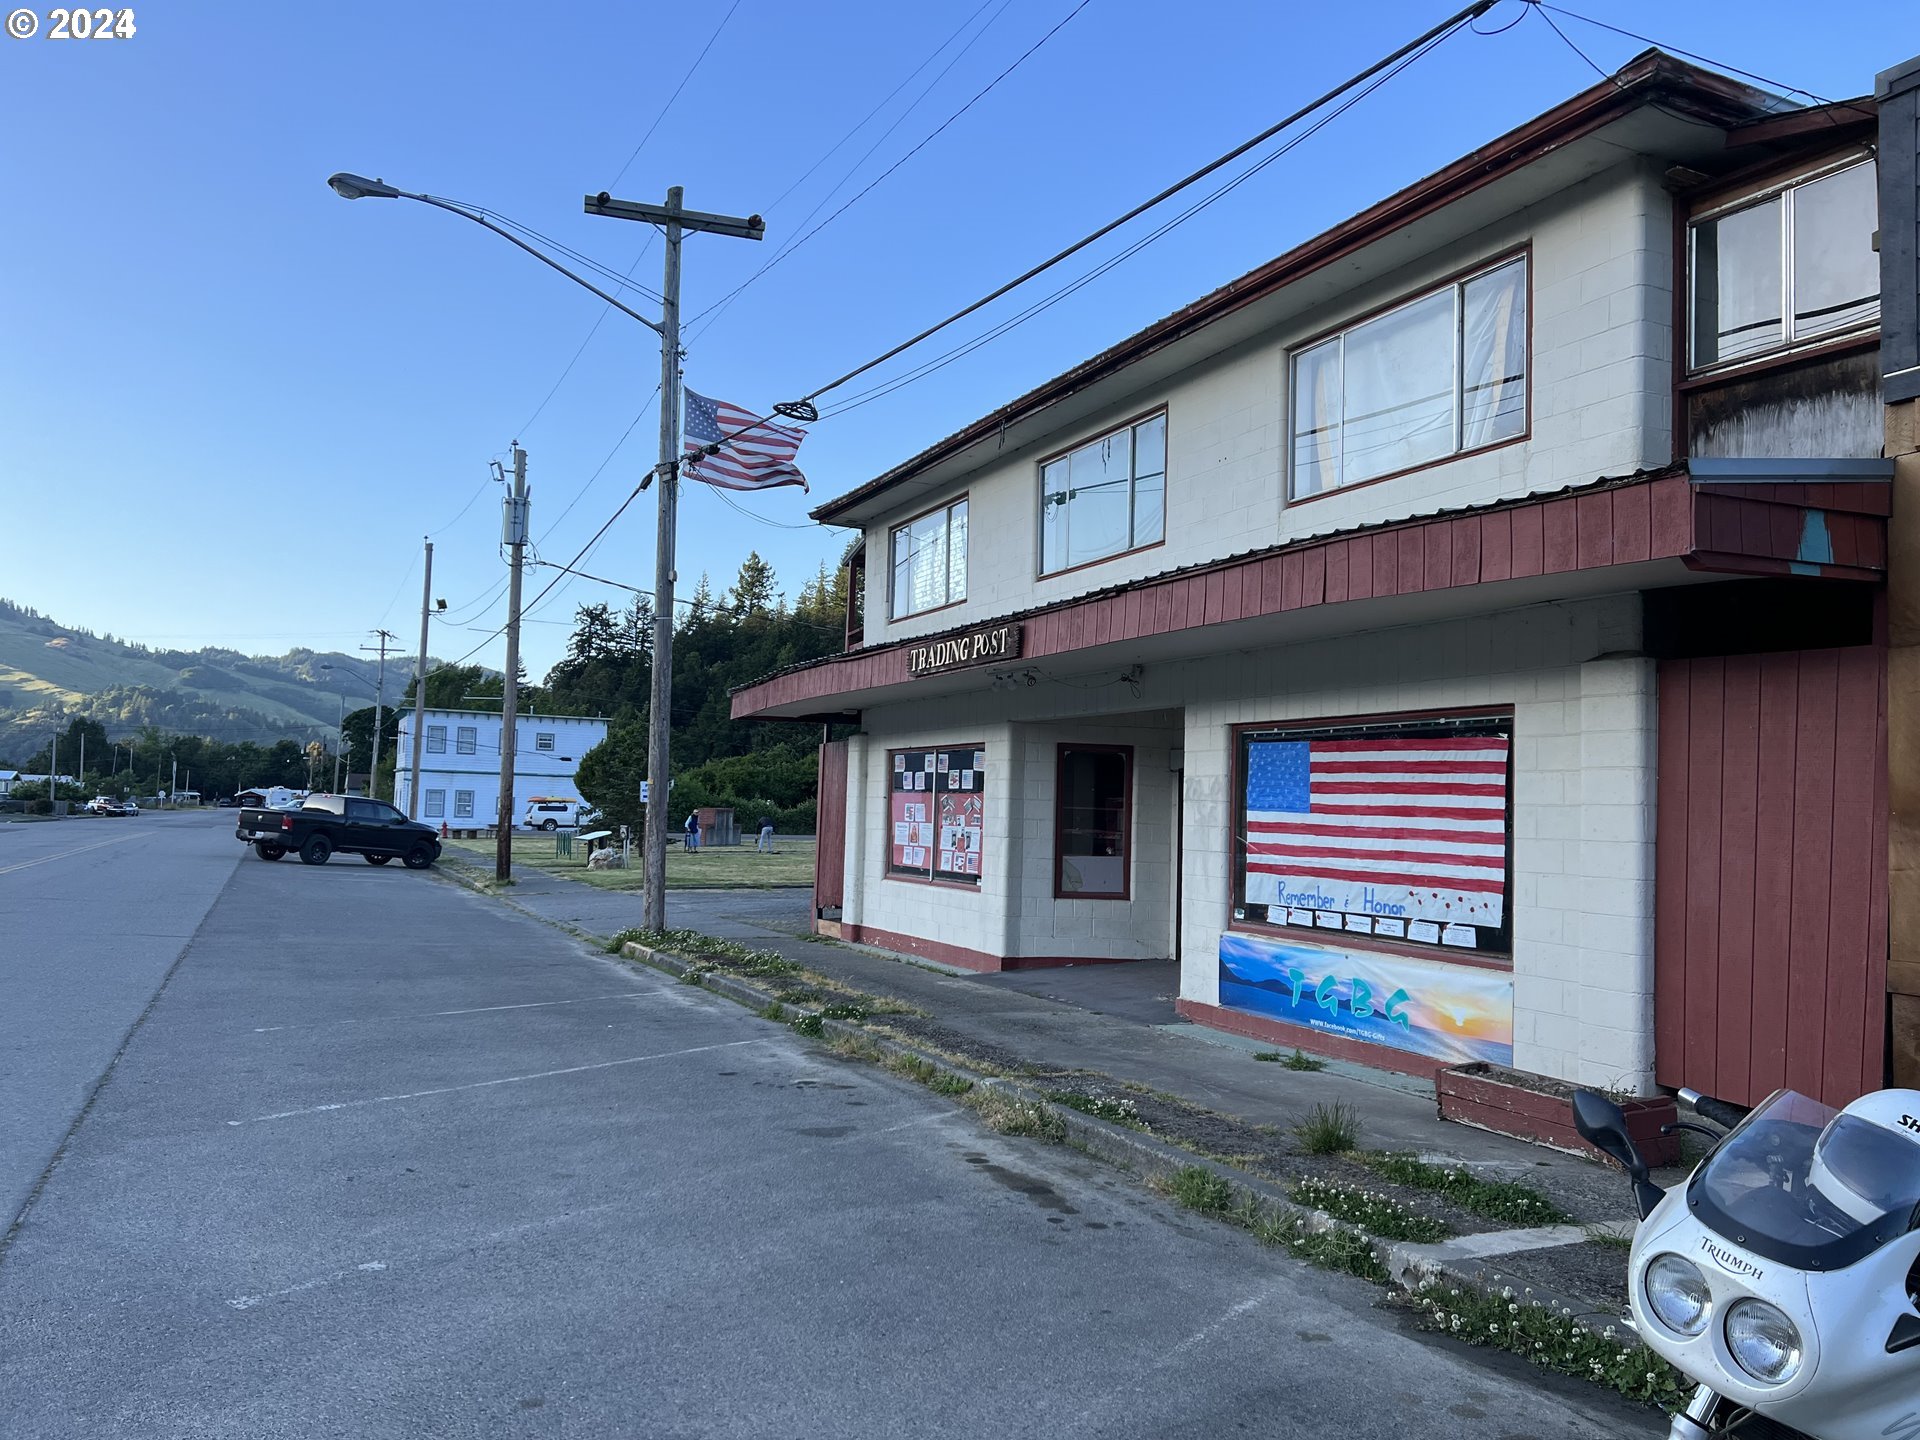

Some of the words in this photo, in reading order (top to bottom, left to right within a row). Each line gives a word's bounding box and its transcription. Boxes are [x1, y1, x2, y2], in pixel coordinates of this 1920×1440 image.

[910, 637, 970, 671] TRADING
[972, 628, 1008, 659] POST
[1278, 881, 1335, 910] Remember
[1363, 887, 1407, 916] Honor
[1288, 967, 1411, 1034] TGBG
[1701, 1235, 1764, 1280] TRIUMPH
